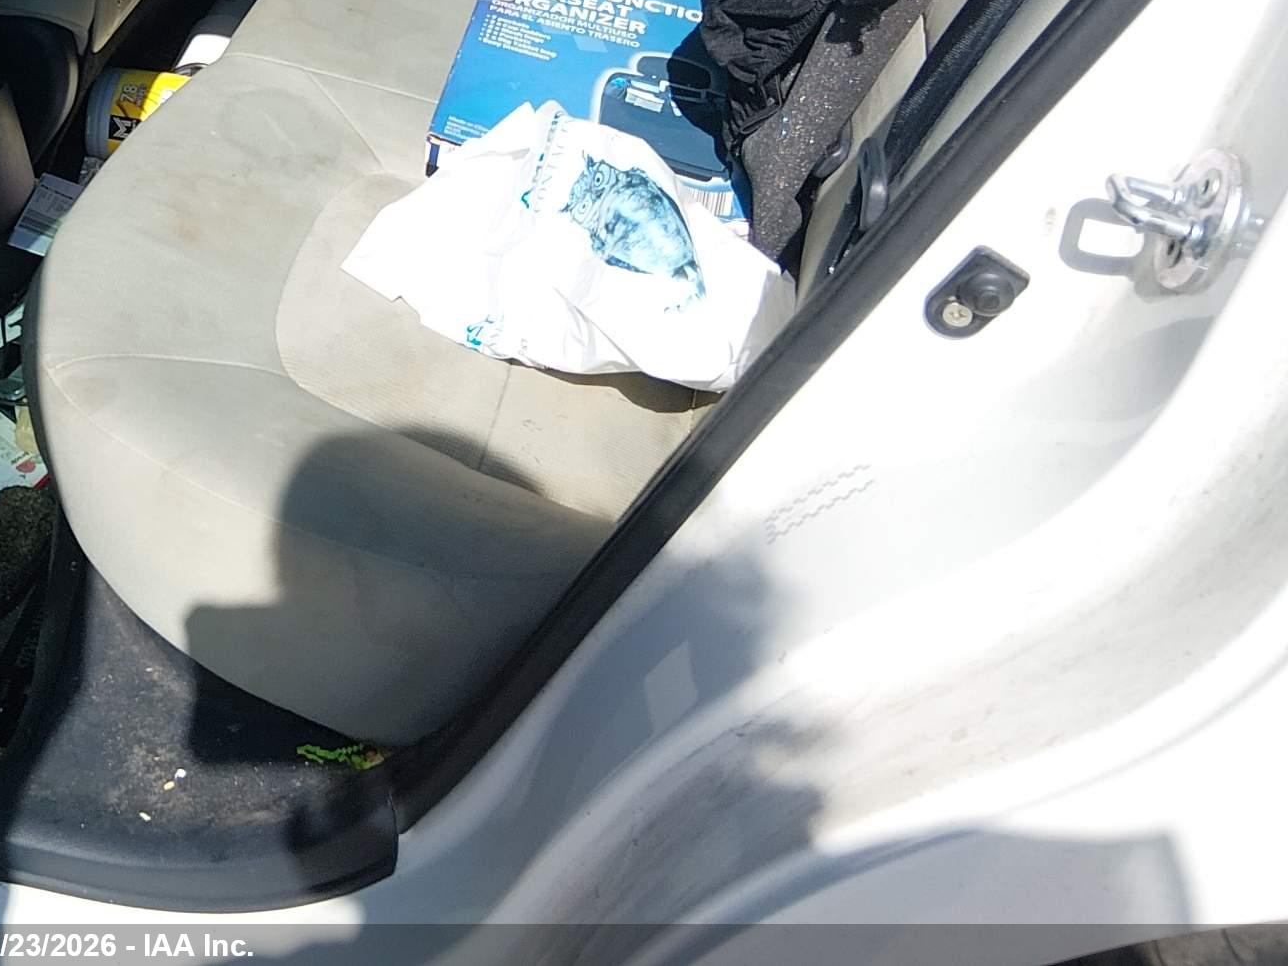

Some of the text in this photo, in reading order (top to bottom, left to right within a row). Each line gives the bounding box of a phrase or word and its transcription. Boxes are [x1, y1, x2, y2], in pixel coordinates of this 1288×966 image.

[489, 4, 520, 18] PARA
[521, 13, 535, 22] EL
[537, 17, 586, 35] ASIENTO
[588, 29, 641, 48] TRASERO
[492, 0, 576, 26] ORGANIZADOR
[577, 17, 638, 40] MULTIUSO
[120, 85, 138, 103] 78
